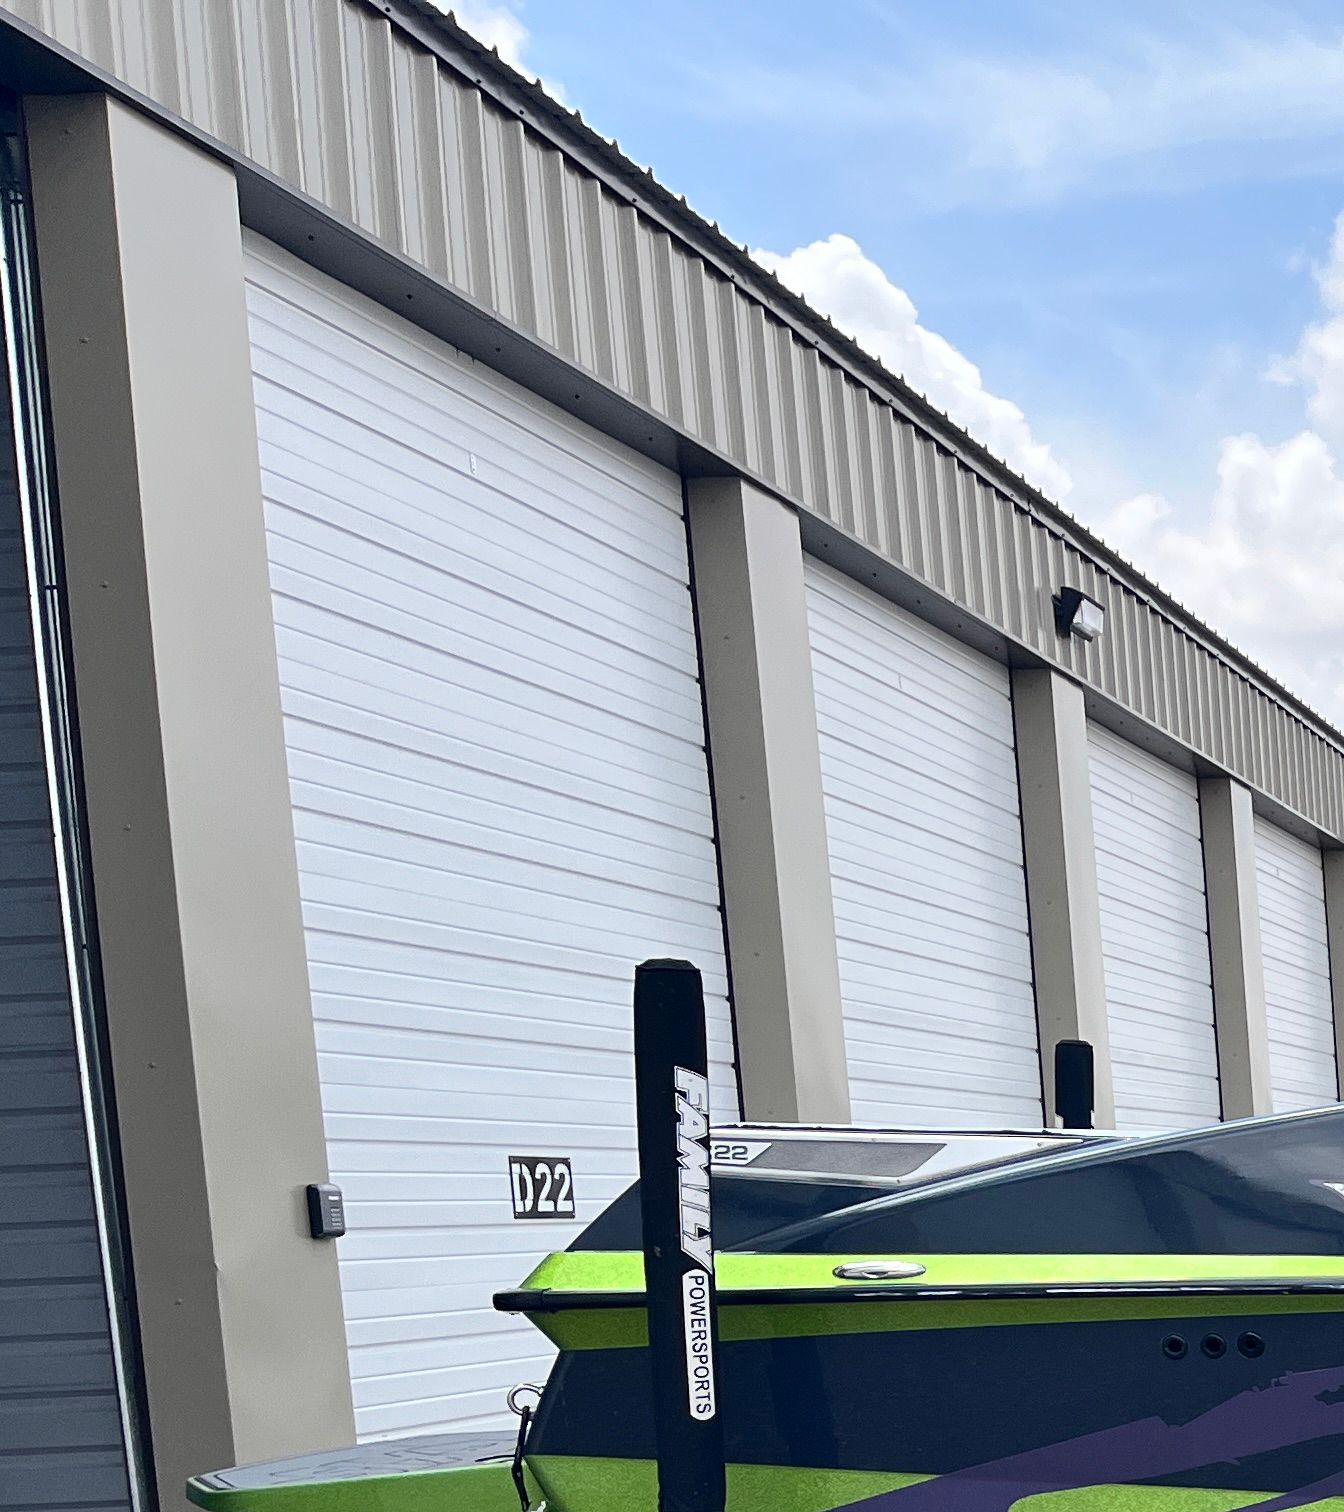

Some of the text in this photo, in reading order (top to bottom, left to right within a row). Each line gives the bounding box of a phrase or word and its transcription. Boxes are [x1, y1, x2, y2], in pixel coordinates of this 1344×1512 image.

[511, 1162, 574, 1213] D22
[674, 1065, 712, 1275] FAMILY
[688, 1275, 712, 1414] POWERSPORTS
